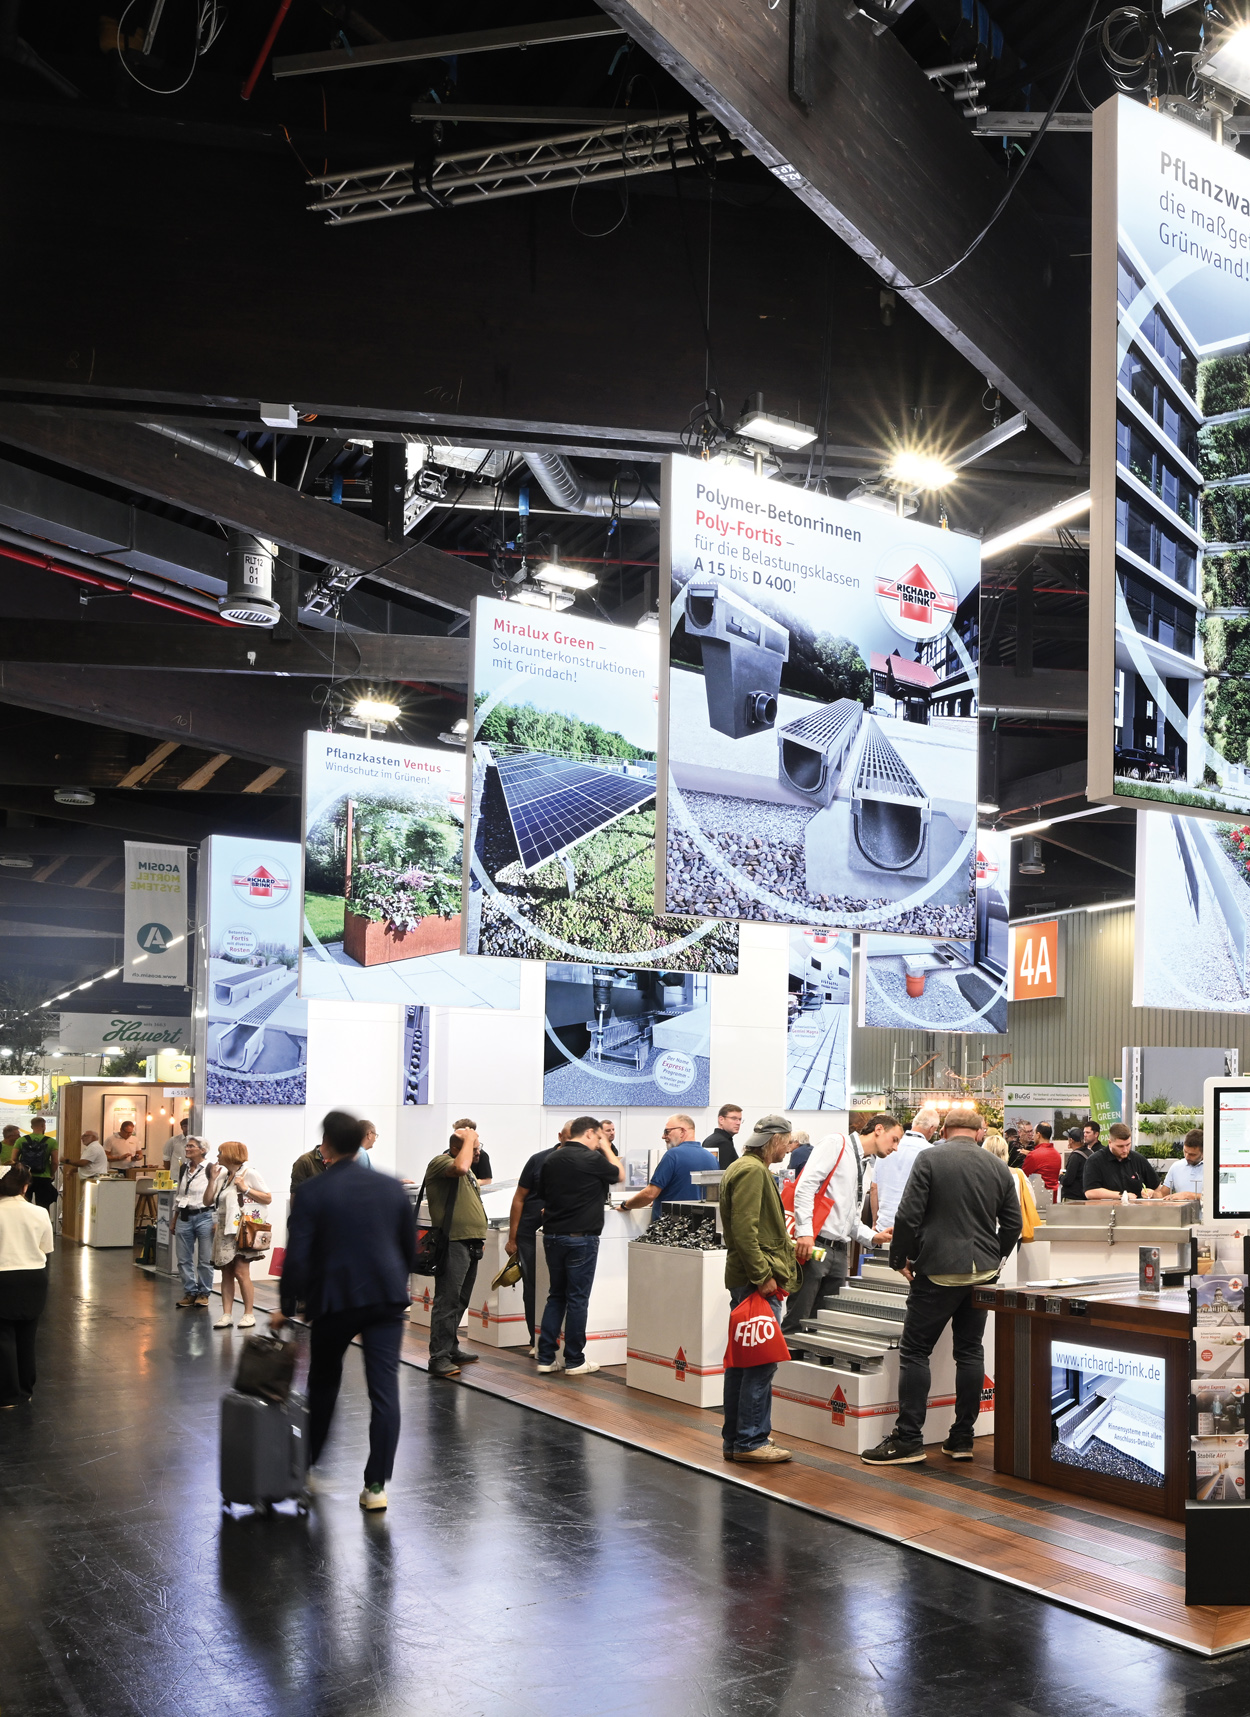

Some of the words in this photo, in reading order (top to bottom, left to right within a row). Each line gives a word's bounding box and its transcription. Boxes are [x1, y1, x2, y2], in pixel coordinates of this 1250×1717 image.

[1159, 190, 1186, 220] die
[1159, 222, 1250, 281] Grünwand!
[696, 483, 862, 543] Polymer-Betonrinnen
[695, 509, 782, 547] Poly-Fortis
[249, 566, 258, 575] 01
[694, 534, 715, 551] für
[717, 539, 739, 559] die
[742, 546, 860, 590] Belastungsklassen
[249, 576, 258, 584] 01
[694, 557, 704, 572] A
[708, 560, 726, 577] 15
[730, 565, 749, 584] bis
[752, 570, 763, 586] D
[765, 574, 797, 595] 400!
[896, 583, 937, 602] RICHARD
[902, 594, 931, 608] BRINK
[494, 618, 549, 642] Miralux
[554, 631, 595, 651] Green
[492, 657, 513, 671] mit
[516, 661, 577, 683] Gründach!
[493, 638, 646, 679] Solarunterkonstruktionen
[326, 746, 401, 768] Pflanzkasten
[404, 758, 441, 773] Ventus
[325, 761, 378, 779] Windschutz
[381, 769, 392, 780] im
[394, 770, 430, 785] Grünen!
[1019, 936, 1052, 986] 4A
[102, 1019, 183, 1044] Hauert
[662, 1060, 684, 1071] Express
[1095, 1101, 1111, 1111] THE
[1097, 1111, 1121, 1121] GREEN
[734, 1318, 775, 1347] FELCO
[1056, 1352, 1161, 1381] www.richard-brink.de
[1108, 1423, 1141, 1435] Rinnensysteme
[1151, 1432, 1162, 1440] allen
[1114, 1434, 1155, 1448] Anschluss-Details!
